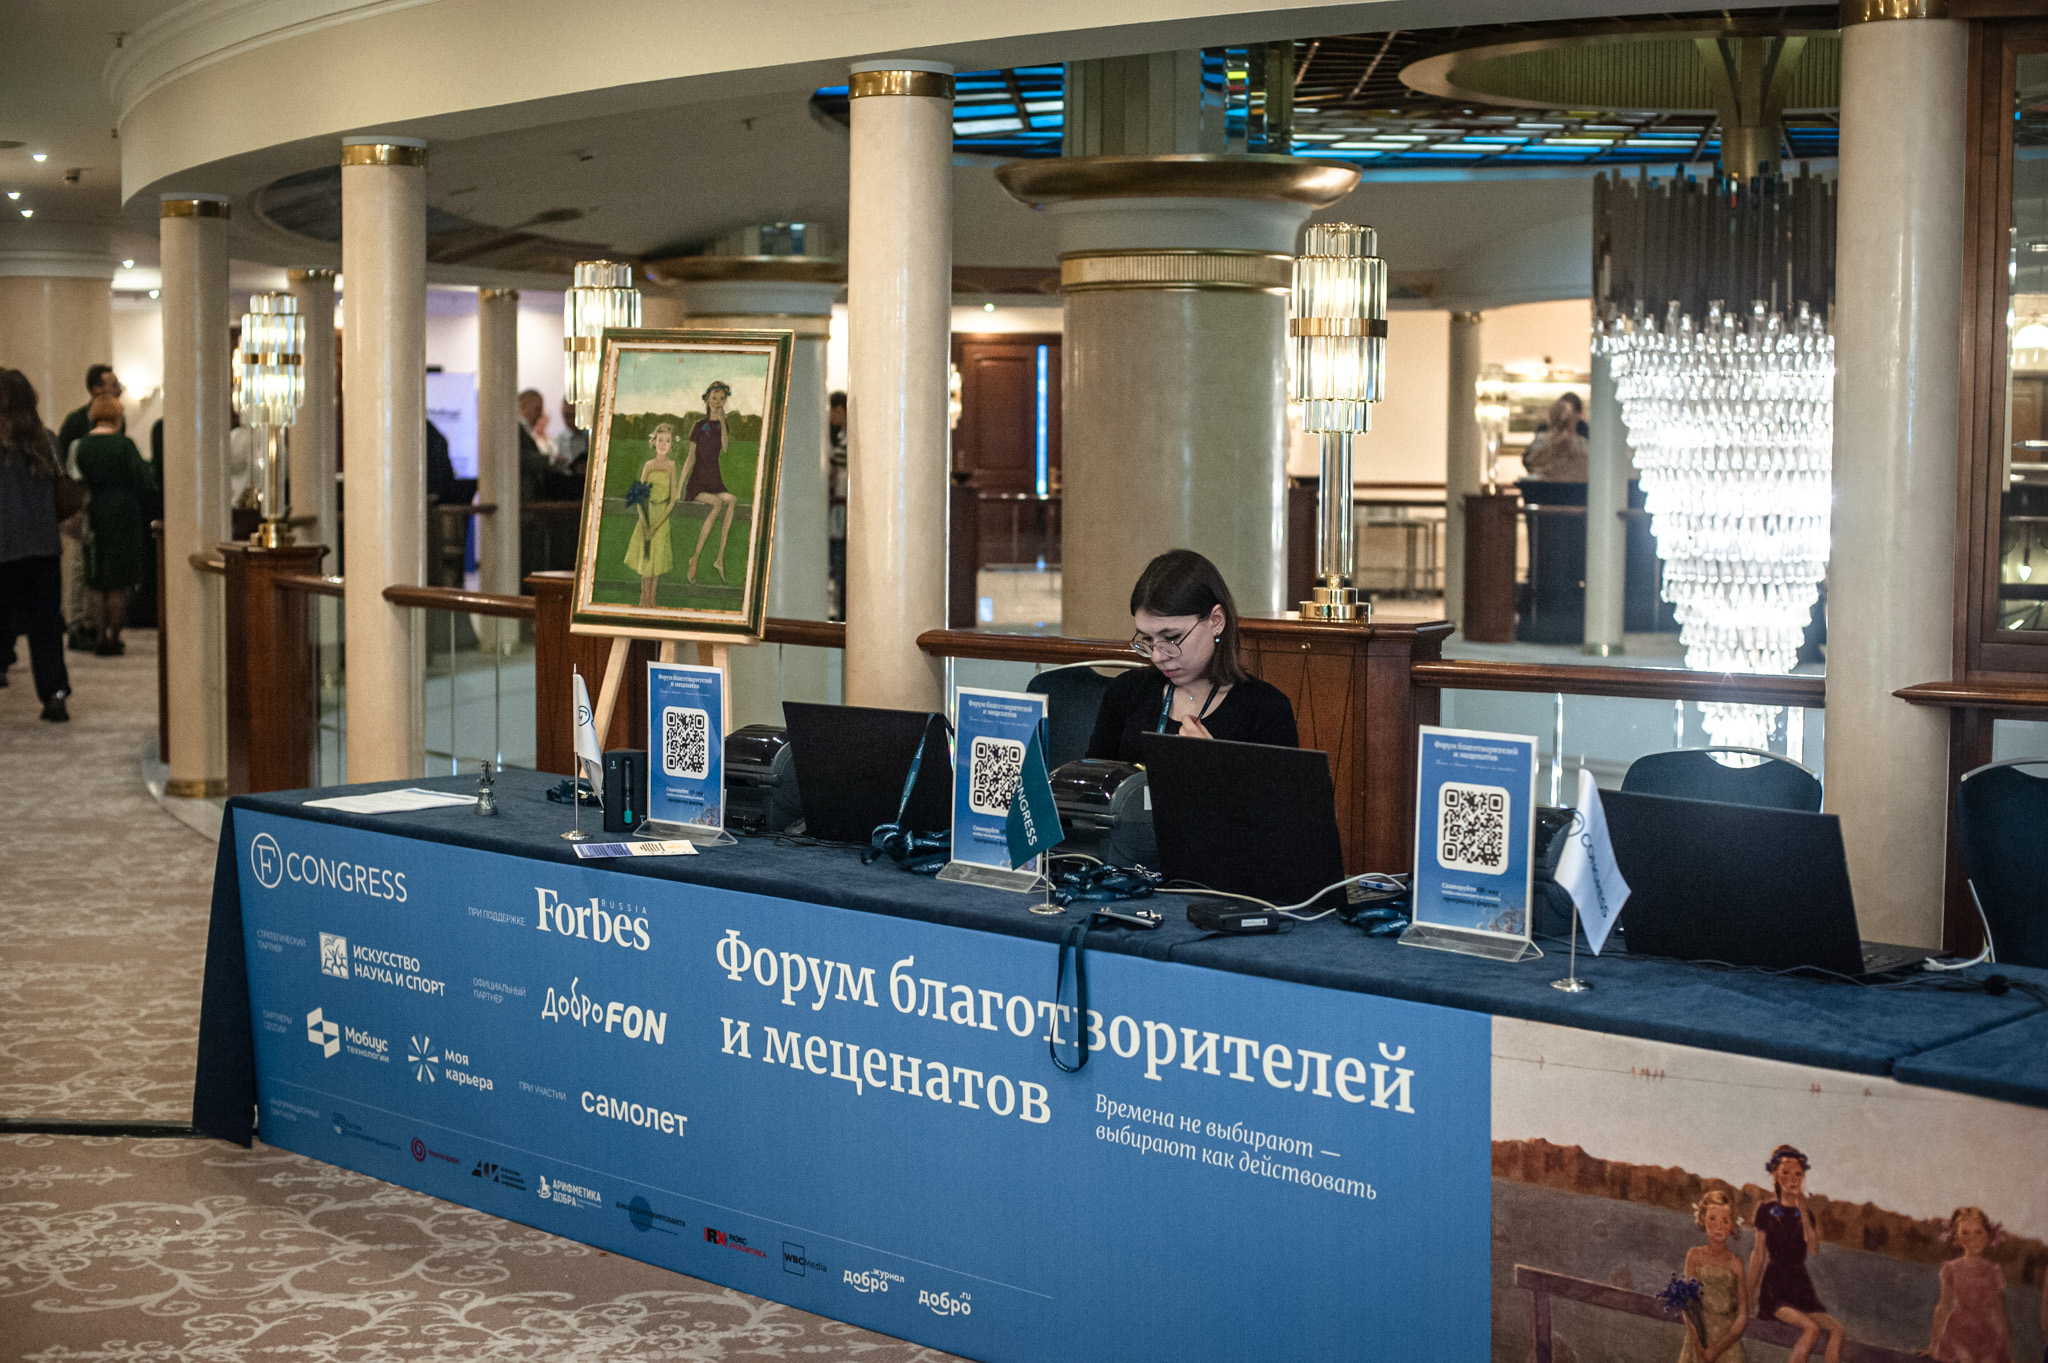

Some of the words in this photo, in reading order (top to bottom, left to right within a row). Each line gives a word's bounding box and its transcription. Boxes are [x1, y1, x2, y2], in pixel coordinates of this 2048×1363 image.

[1016, 775, 1038, 846] ONGRESS
[286, 852, 408, 903] CONGRESS
[468, 906, 483, 918] ПРИ
[483, 909, 526, 927] ПОДДЕРЖКЕ
[534, 886, 651, 951] Forbes
[601, 899, 648, 915] RUSSIA
[352, 944, 421, 973] ИСКУССТВО
[354, 962, 394, 985] НАУКА
[394, 971, 405, 988] И
[405, 974, 446, 997] СПОРТ
[472, 976, 527, 998] ОФИЦИАЛЬНЫЙ
[473, 989, 504, 1004] ПАРТНЕР
[716, 929, 879, 1011] Форум
[890, 955, 1415, 1114] благотворителей
[344, 1025, 389, 1053] Мобиус
[346, 1044, 390, 1063] технологии
[444, 1048, 469, 1066] Моя
[445, 1068, 494, 1091] карьера
[720, 1016, 752, 1059] и
[763, 1026, 1051, 1124] меценатов
[580, 1090, 688, 1138] самолет
[1095, 1093, 1174, 1129] Времена
[1180, 1116, 1202, 1134] не
[1206, 1121, 1314, 1159] выбирают
[1095, 1125, 1197, 1161] выбирают
[1202, 1143, 1235, 1169] как
[1238, 1151, 1378, 1201] действовать
[552, 1179, 602, 1203] АРИФМЕТИКА
[553, 1190, 577, 1207] ДОБРА
